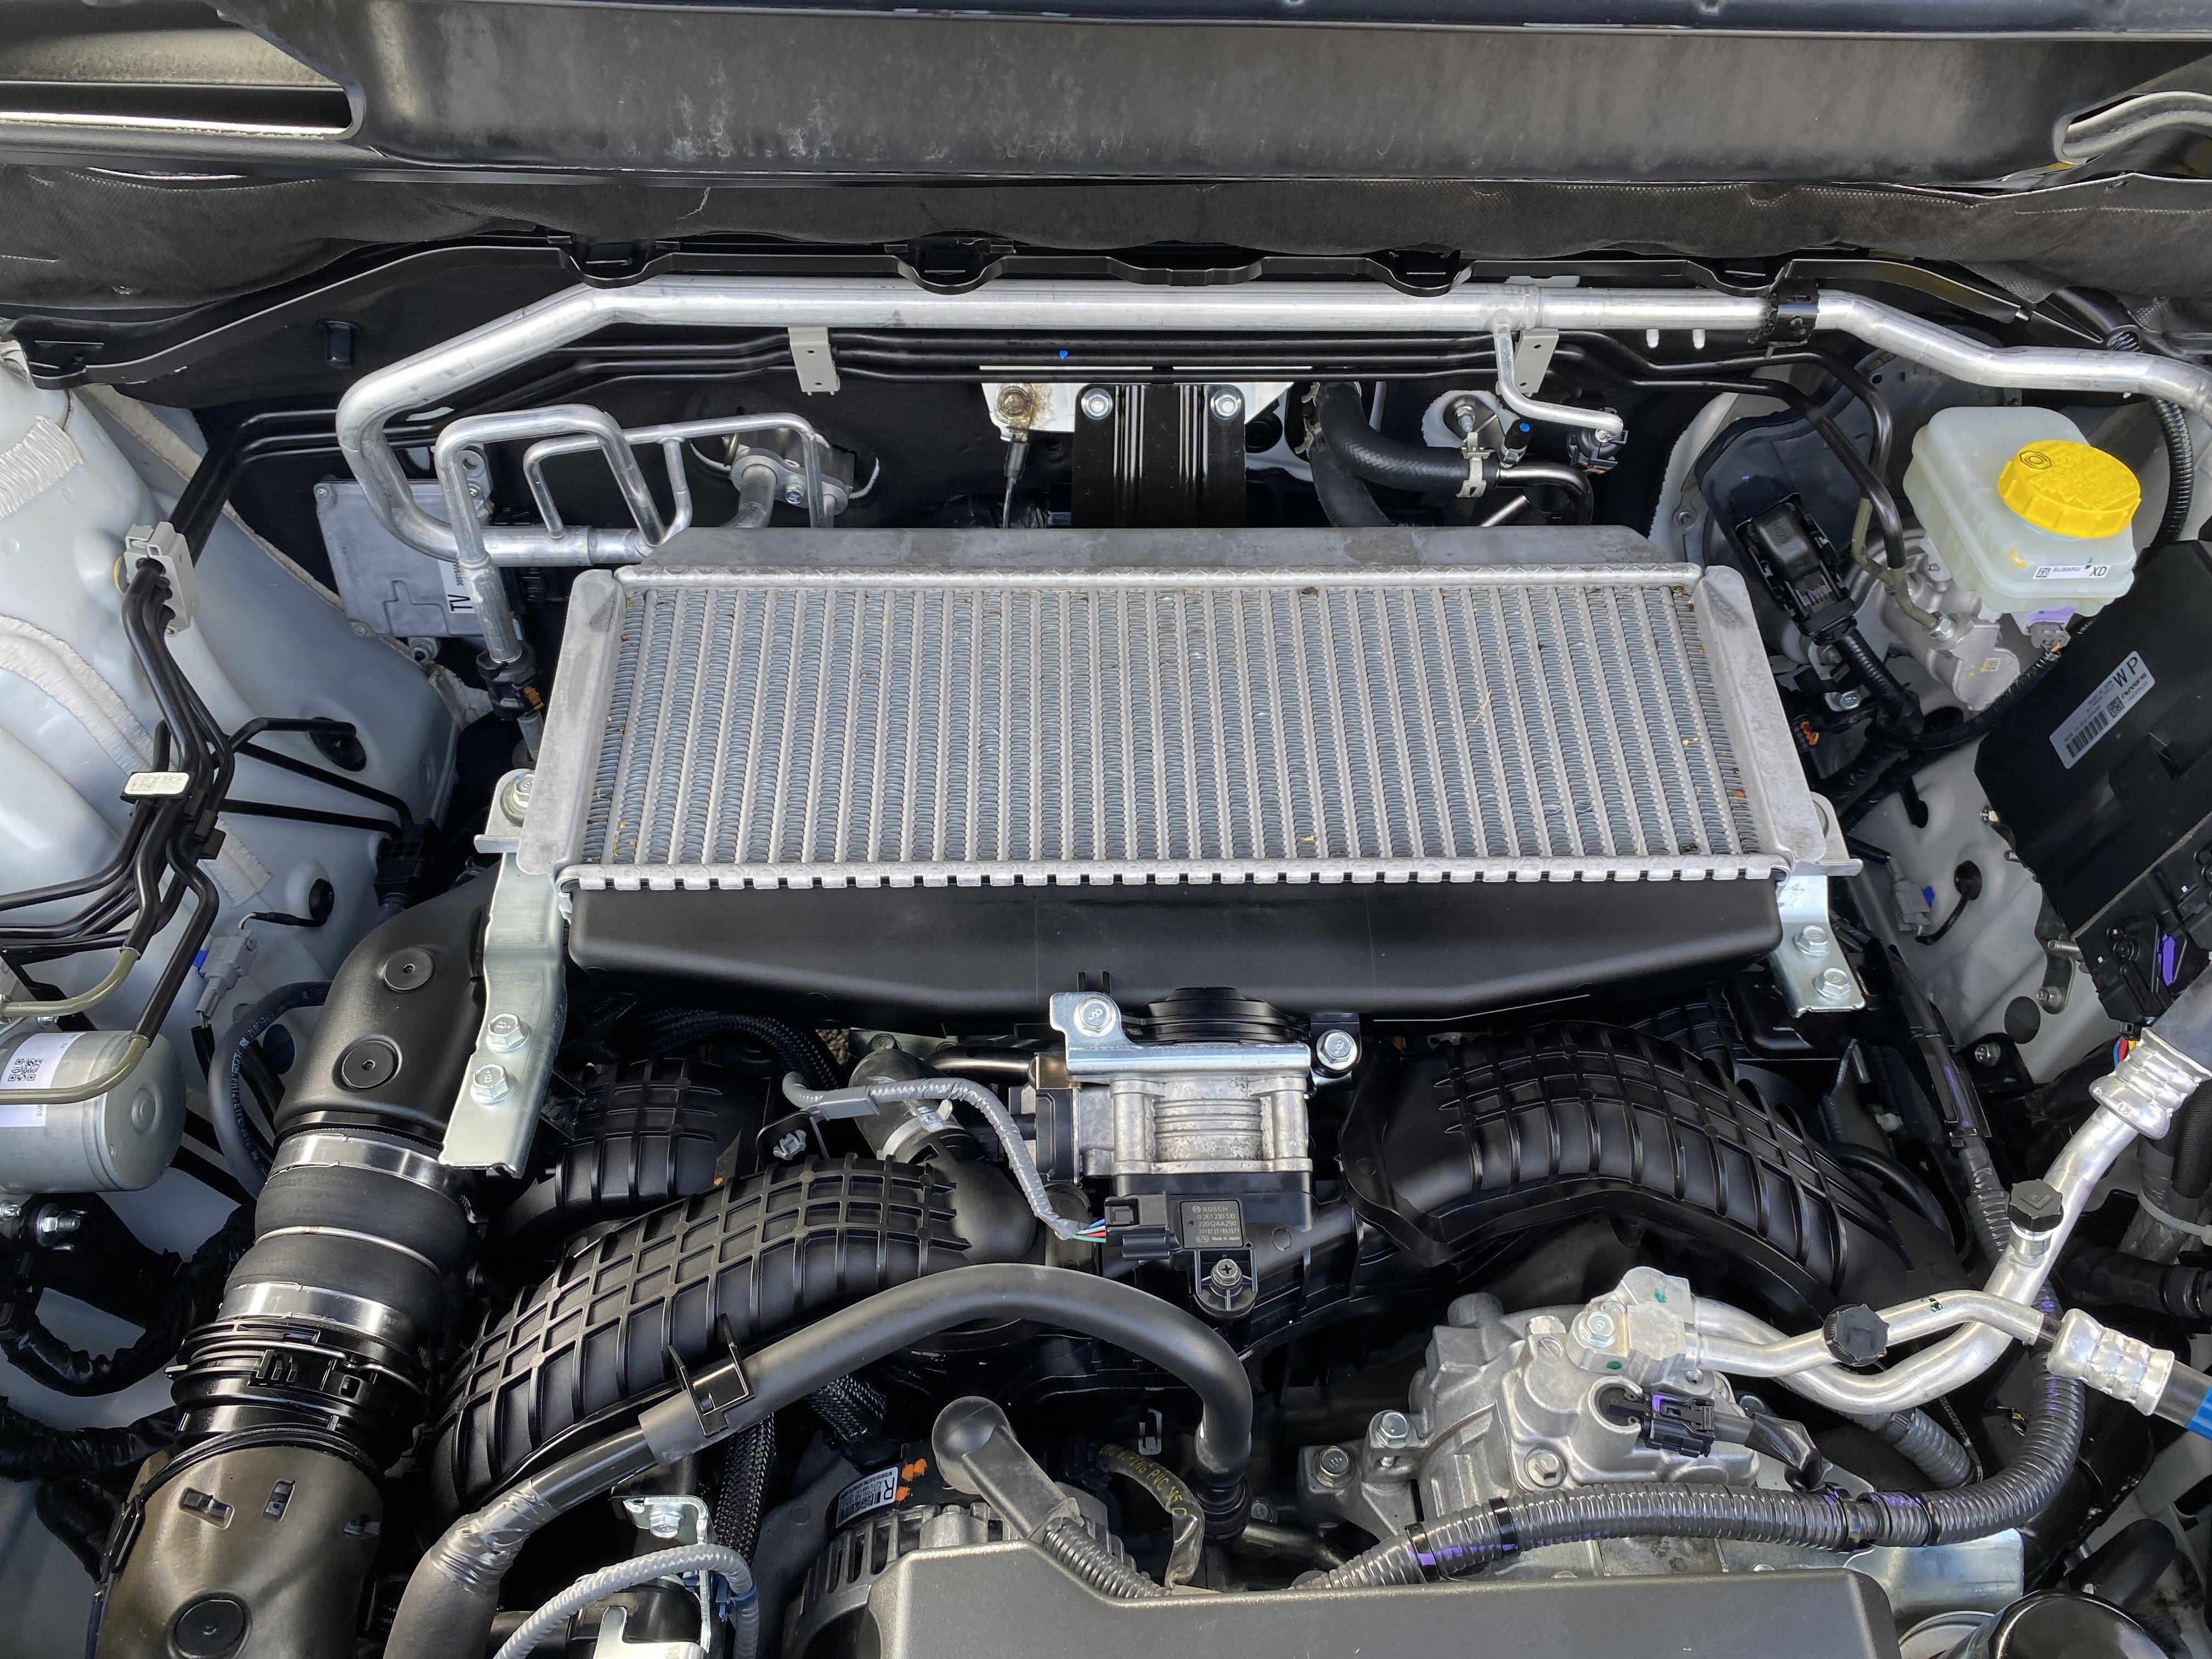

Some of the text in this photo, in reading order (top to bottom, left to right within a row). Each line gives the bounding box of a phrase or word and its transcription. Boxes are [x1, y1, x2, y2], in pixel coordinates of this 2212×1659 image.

[2089, 566, 2107, 577] XD
[448, 594, 473, 611] TV
[162, 775, 182, 784] B2
[883, 1477, 895, 1500] R
